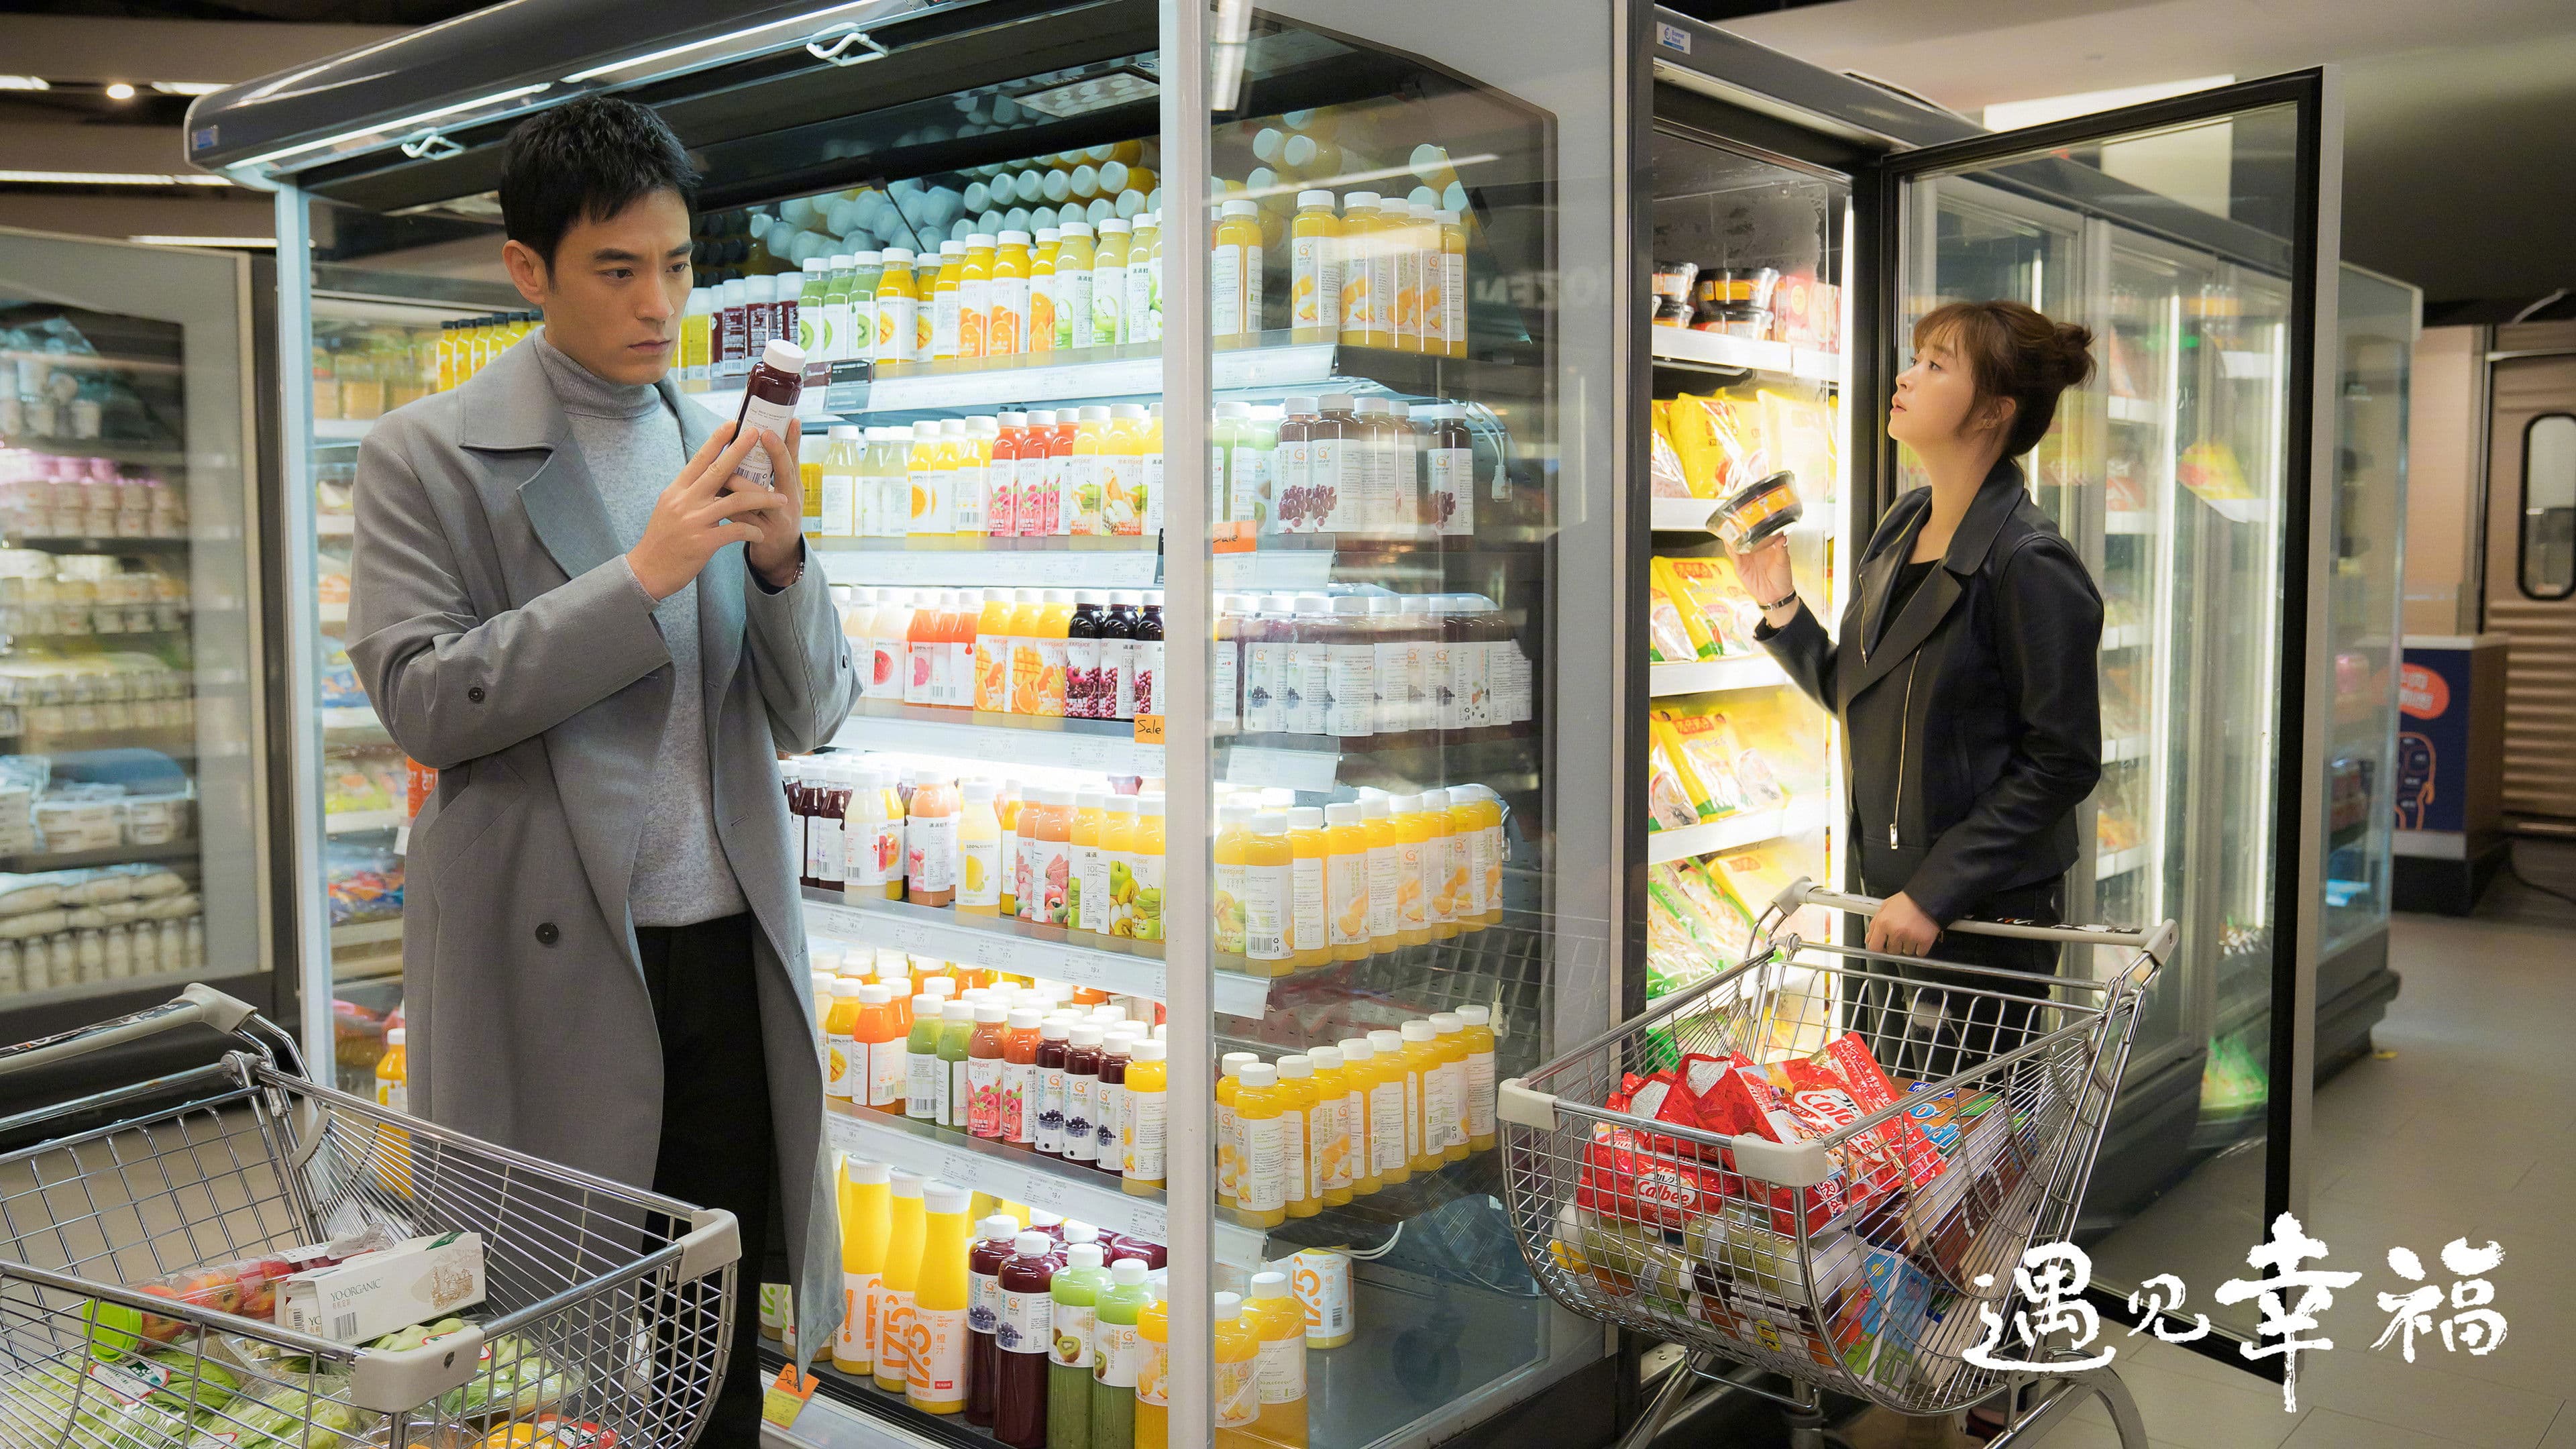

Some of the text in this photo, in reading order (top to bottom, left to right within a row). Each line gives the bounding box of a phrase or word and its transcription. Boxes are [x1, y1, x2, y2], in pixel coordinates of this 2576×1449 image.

[1137, 718, 1161, 735] Sale
[1638, 1180, 1690, 1207] Calbee
[936, 1333, 947, 1355] 橙汁
